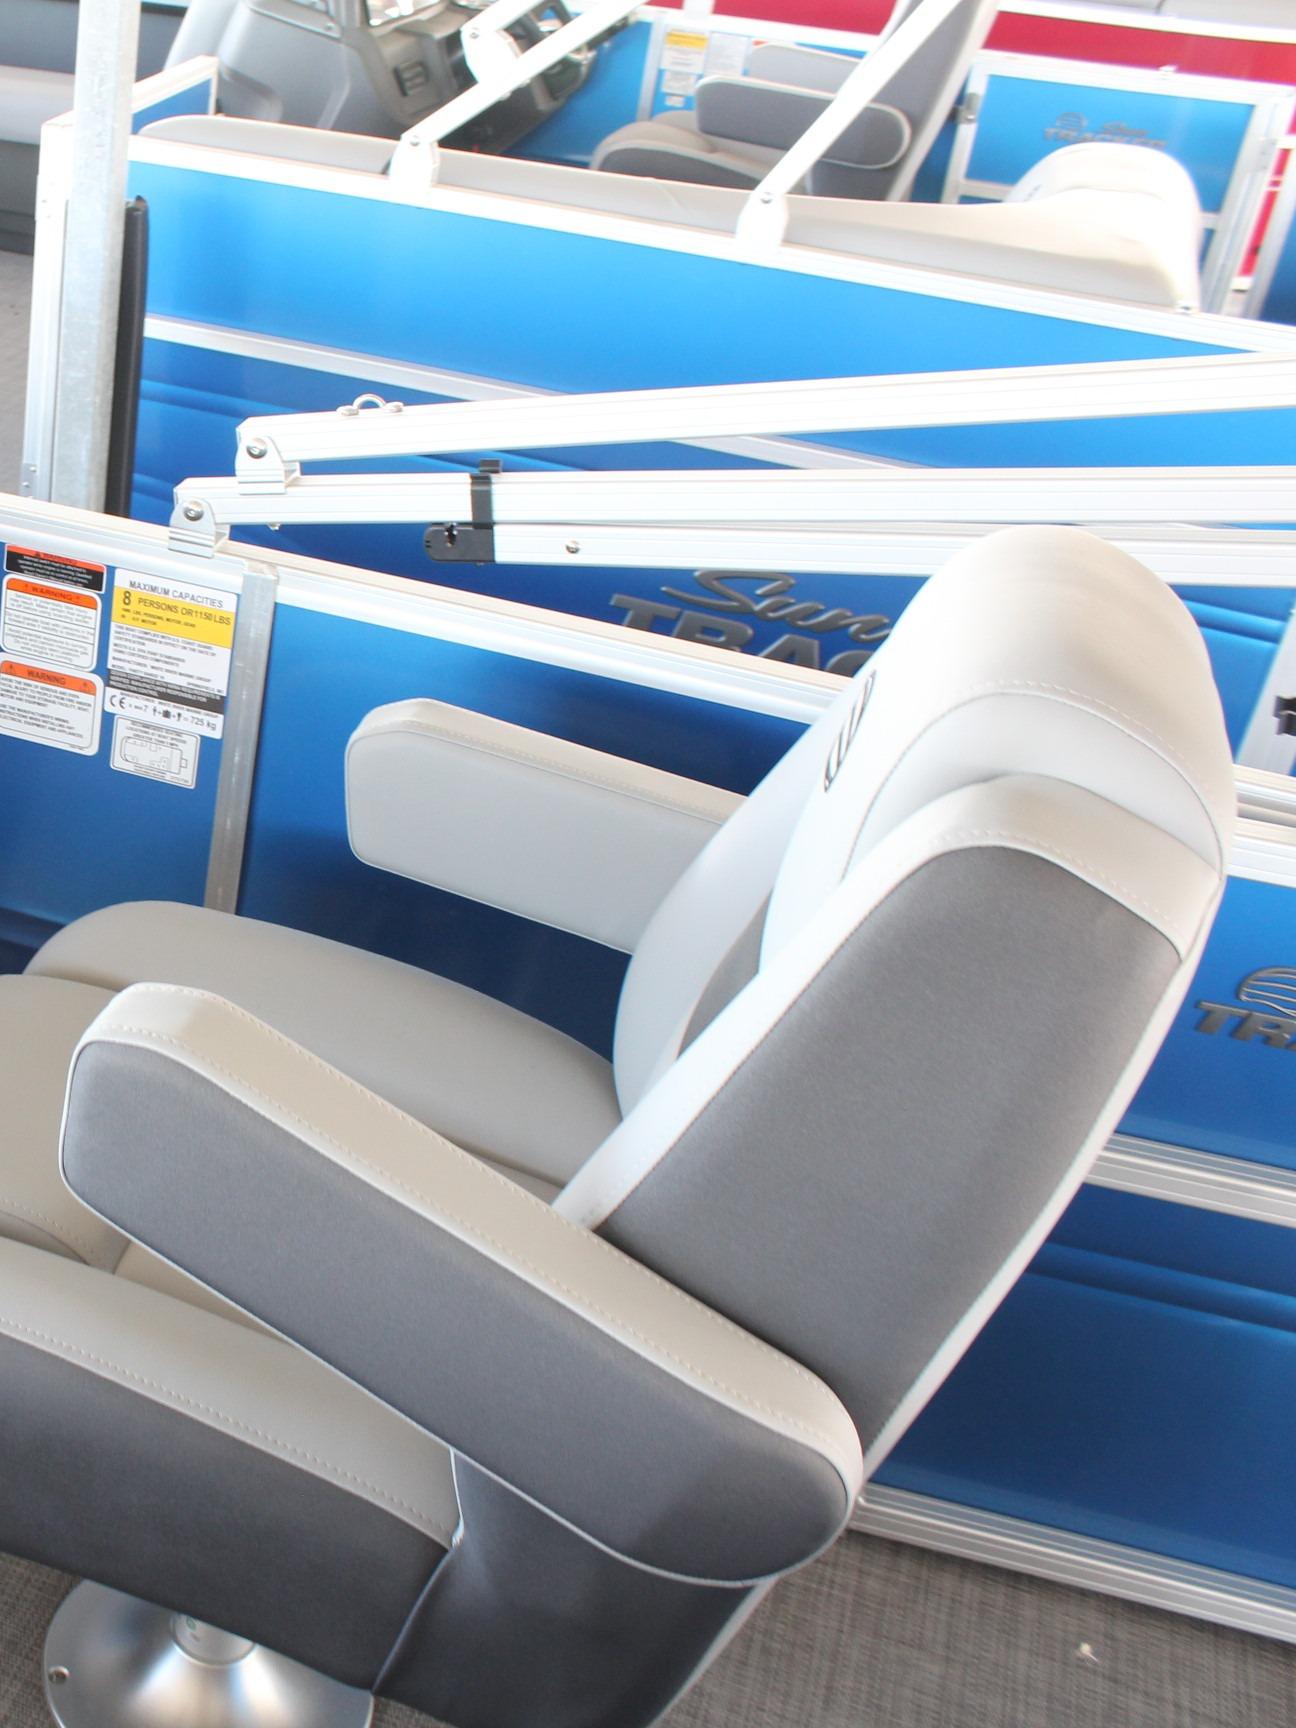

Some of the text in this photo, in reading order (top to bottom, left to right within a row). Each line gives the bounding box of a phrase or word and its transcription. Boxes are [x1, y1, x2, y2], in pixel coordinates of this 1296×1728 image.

[31, 586, 73, 601] WARNING
[122, 590, 132, 606] 8
[138, 597, 178, 614] PERSONS
[213, 613, 231, 626] LBS
[129, 580, 224, 608] MAXIMUM CAPACITIES
[660, 570, 893, 643] Sun
[27, 669, 66, 686] WARNING
[1195, 1000, 1296, 1052] TR
